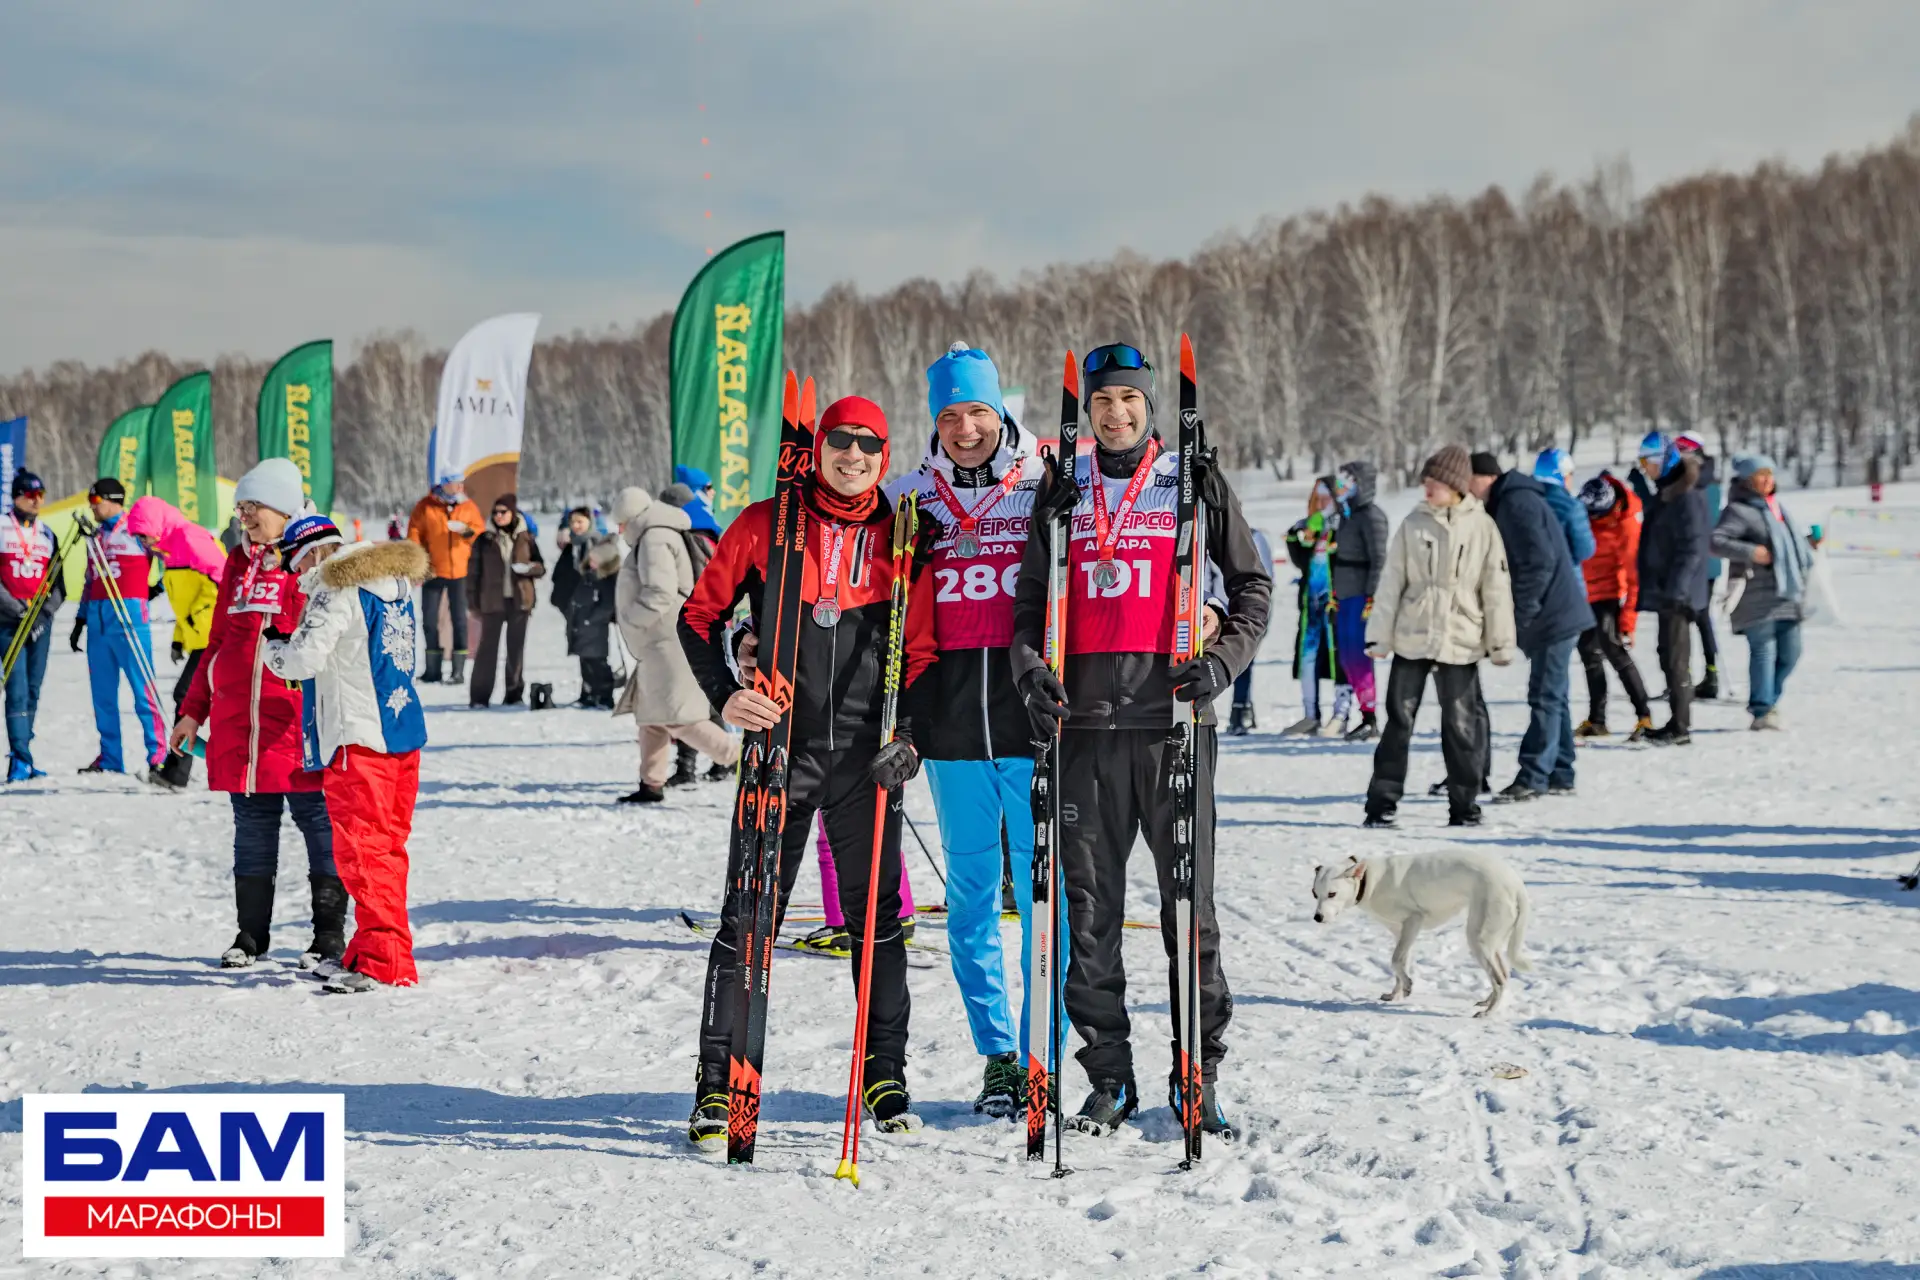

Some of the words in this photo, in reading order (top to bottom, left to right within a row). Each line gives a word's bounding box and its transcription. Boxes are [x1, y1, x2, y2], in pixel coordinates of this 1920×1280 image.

[1129, 466, 1148, 498] АНГАРА
[1183, 442, 1194, 504] ROSSIGNOL
[774, 488, 790, 546] ROSSIGNOL
[1094, 489, 1104, 521] АНГАРА
[1081, 560, 1152, 598] 191
[745, 932, 753, 965] PREMIUM
[762, 936, 771, 969] PREMIUM
[744, 965, 752, 991] X-IUM
[760, 968, 769, 995] X-IUM
[738, 1120, 757, 1142] 188
